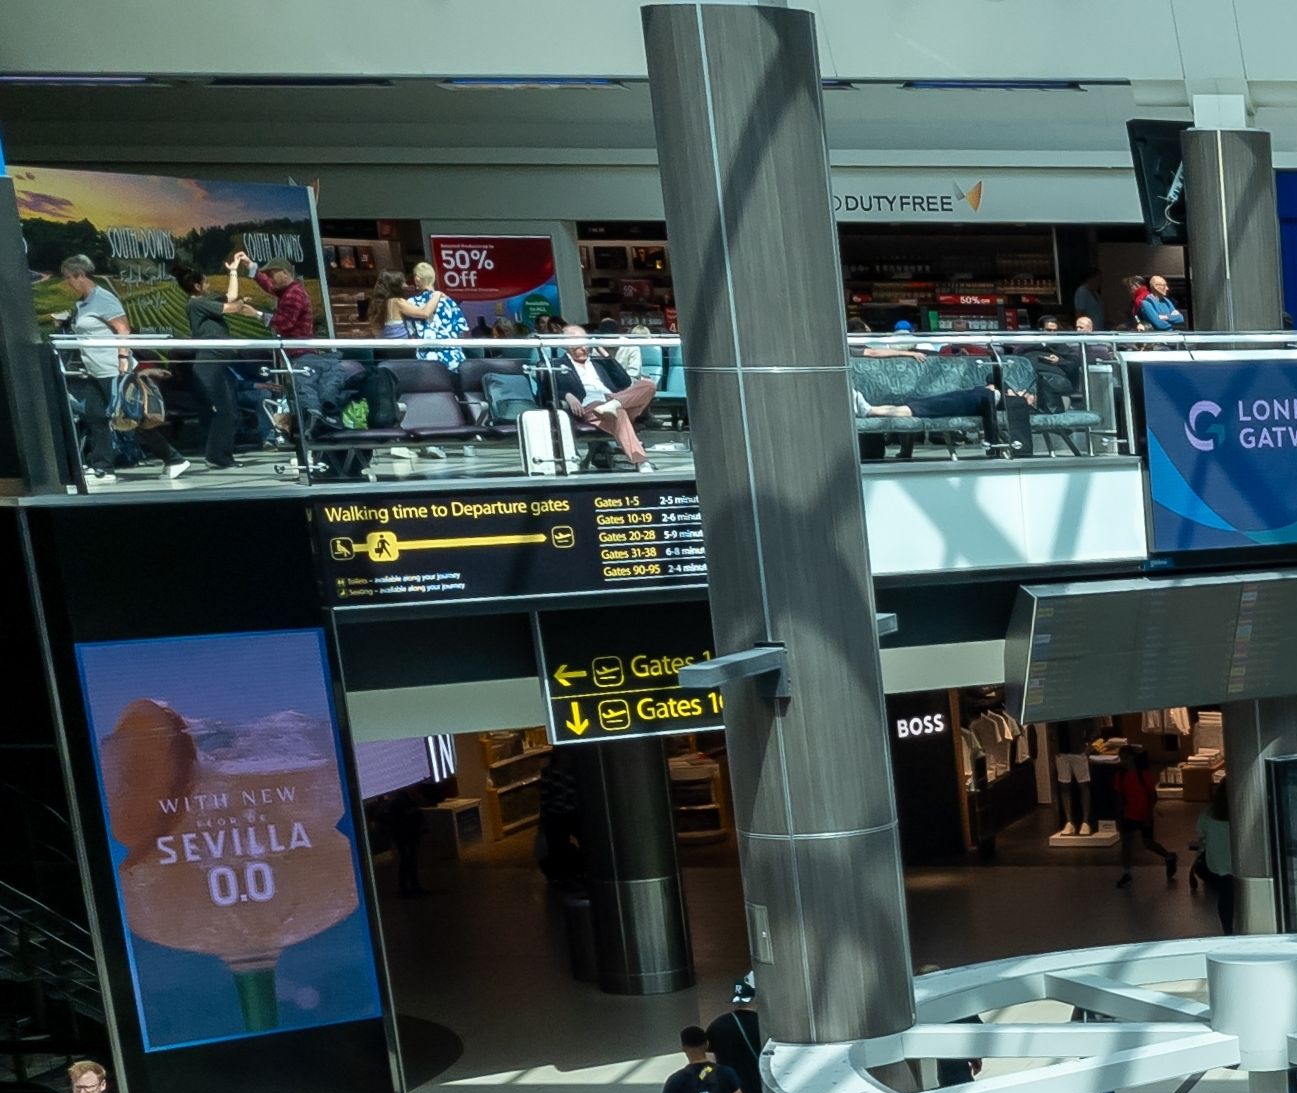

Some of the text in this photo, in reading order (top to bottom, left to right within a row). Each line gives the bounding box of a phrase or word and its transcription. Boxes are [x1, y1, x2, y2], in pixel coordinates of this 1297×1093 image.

[107, 228, 175, 259] SOUTH DOWNS
[243, 233, 303, 262] SOUTH DOWNS
[441, 250, 494, 270] 50%
[444, 271, 477, 287] Off
[325, 499, 570, 523] Walking time to Departure gates
[595, 497, 622, 508] Gates
[625, 496, 640, 506] 1-5
[660, 496, 673, 505] 2-5
[597, 515, 625, 525] Gates
[628, 513, 652, 523] 10-19
[662, 513, 676, 522] 2-6
[599, 531, 626, 542] Gates
[629, 530, 656, 540] 20-28
[664, 530, 677, 539] 5-9
[601, 549, 629, 560] Gates
[631, 547, 657, 558] 31-38
[666, 547, 680, 556] 6-8
[603, 566, 631, 577] Gates
[633, 564, 660, 575] 90-95
[668, 565, 681, 573] 2-4
[631, 654, 695, 678] Gates
[637, 697, 702, 720] Gates
[897, 713, 944, 738] BOSS
[159, 786, 295, 814] WITH NEW
[156, 821, 312, 865] SEVILLA
[208, 861, 275, 907] 0.0
